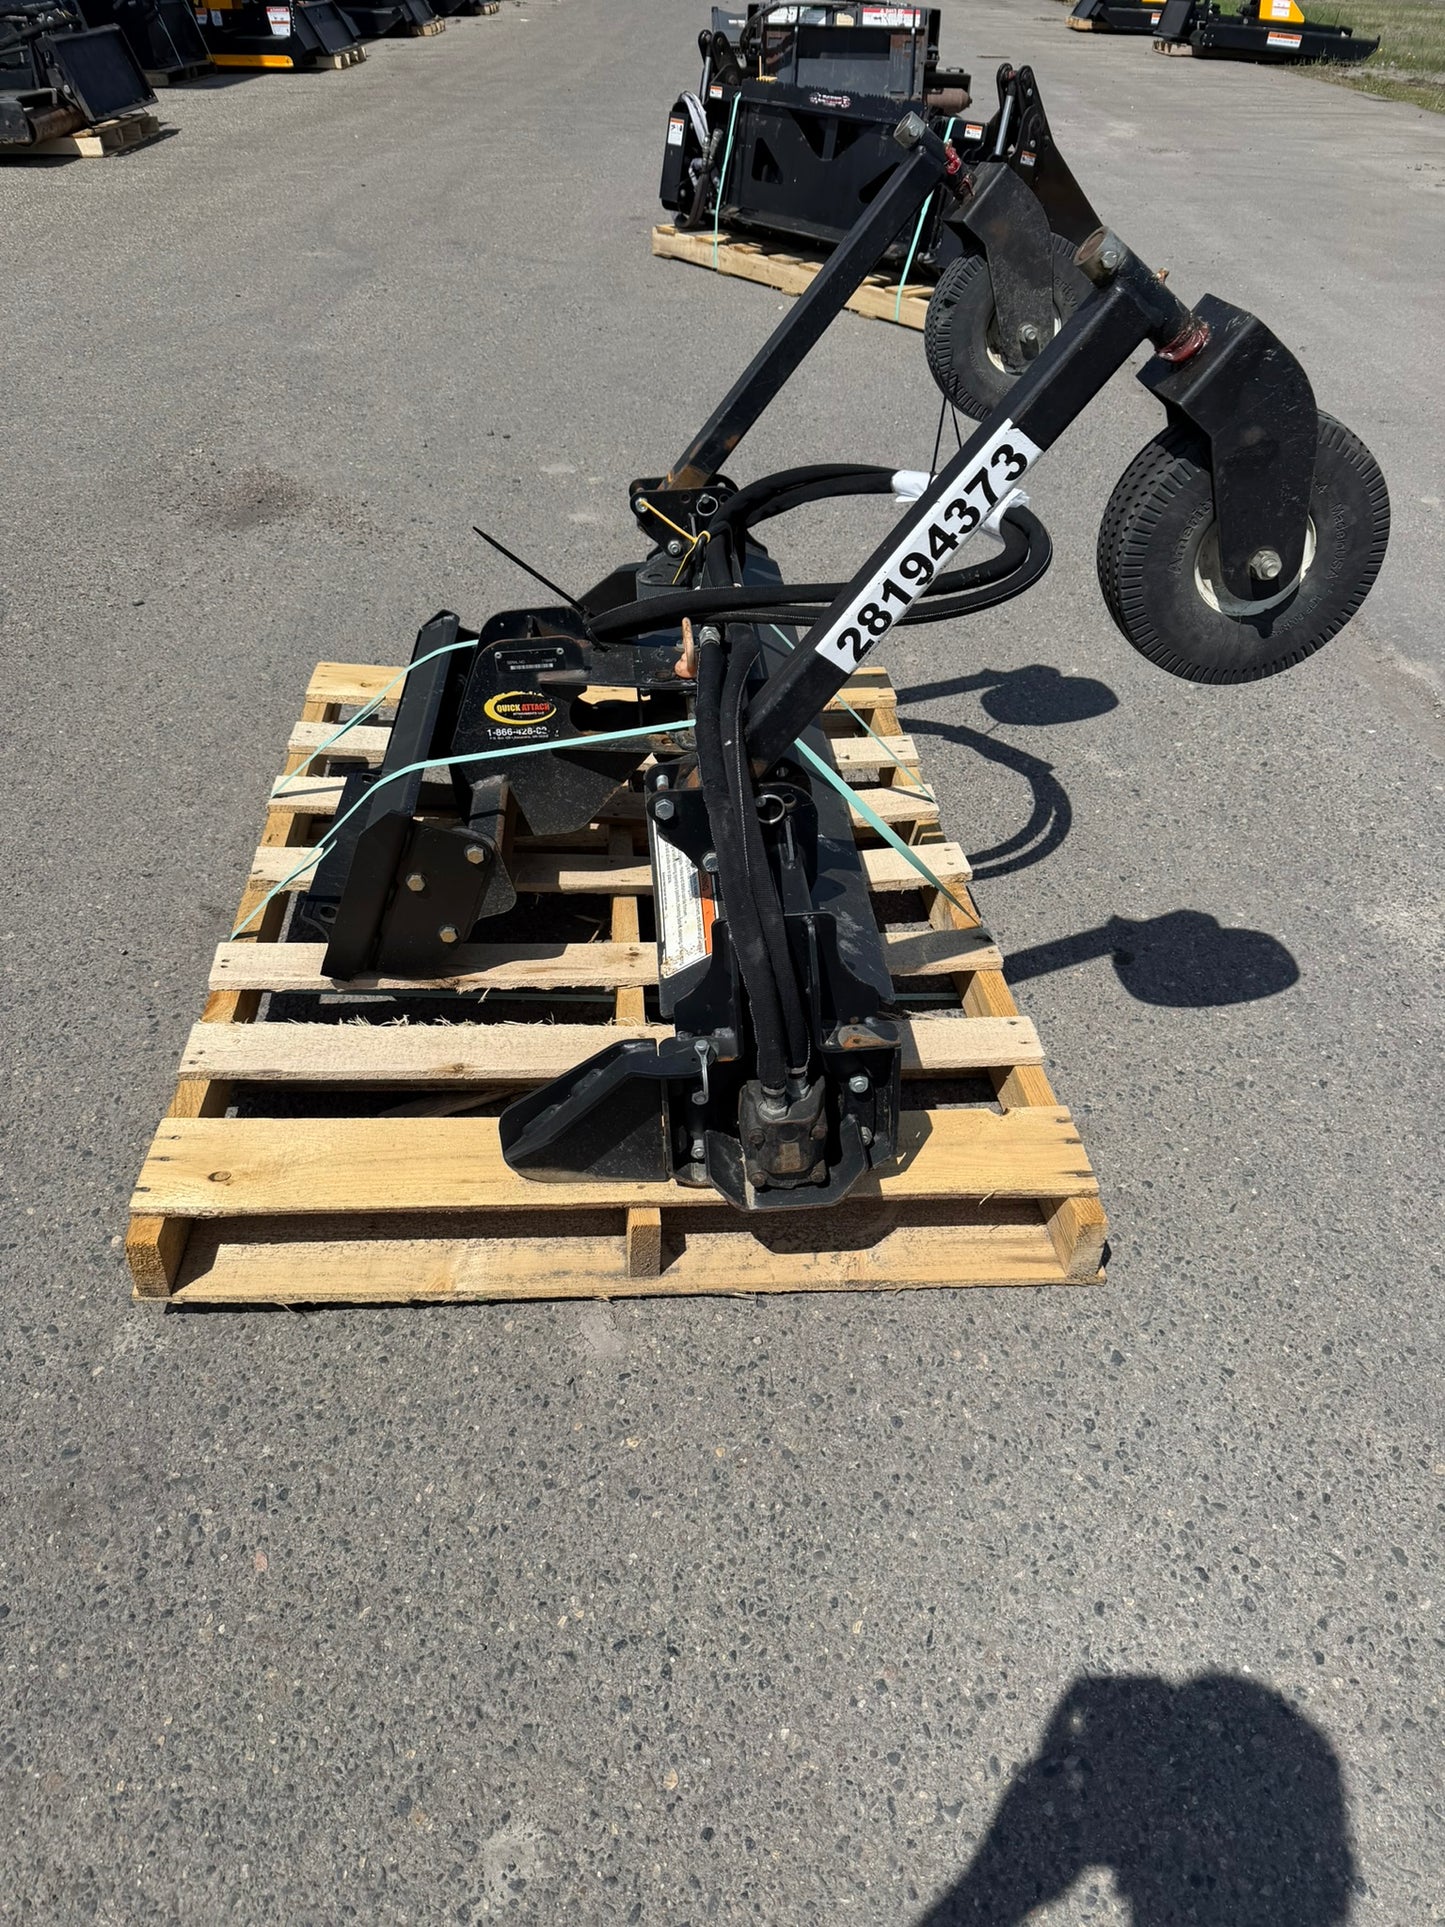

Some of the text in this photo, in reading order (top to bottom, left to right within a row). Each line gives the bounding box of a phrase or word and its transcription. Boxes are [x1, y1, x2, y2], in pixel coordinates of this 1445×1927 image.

[836, 443, 1028, 663] 28194373
[496, 702, 550, 713] QUICK ATTACH
